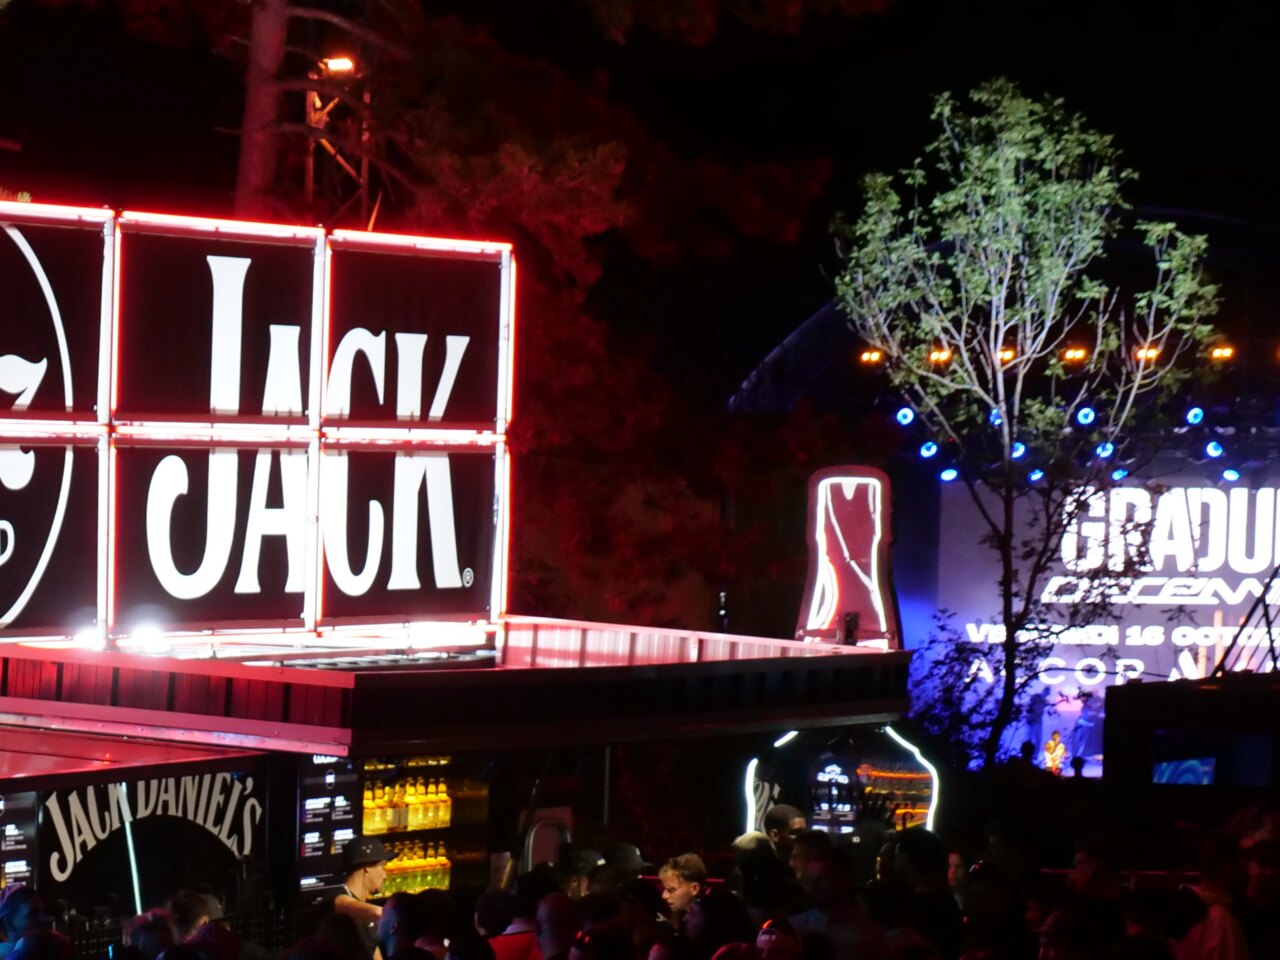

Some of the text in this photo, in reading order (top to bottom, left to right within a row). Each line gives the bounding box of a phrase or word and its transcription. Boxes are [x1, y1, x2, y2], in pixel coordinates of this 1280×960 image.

[146, 255, 471, 599] JACK
[1060, 485, 1280, 574] GRADU
[45, 772, 263, 882] JACK DANIEL'S
